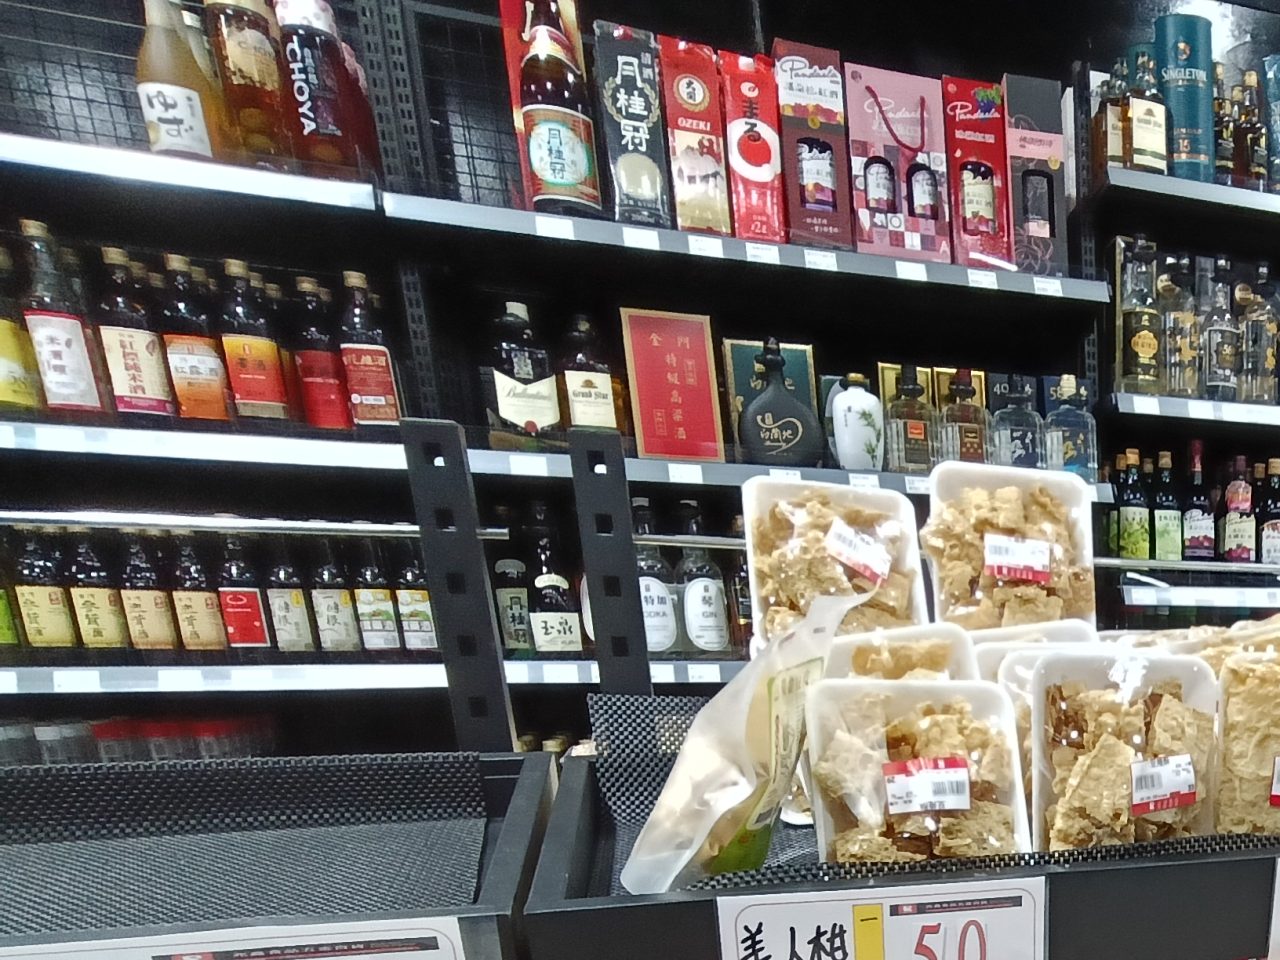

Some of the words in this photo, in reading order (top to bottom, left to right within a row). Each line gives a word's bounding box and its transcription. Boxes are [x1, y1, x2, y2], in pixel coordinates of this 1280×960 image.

[286, 42, 317, 136] CHOYA
[615, 55, 650, 152] 月桂冠
[678, 117, 711, 131] OZEKI
[547, 127, 566, 179] 月桂冠
[993, 383, 1009, 394] 40
